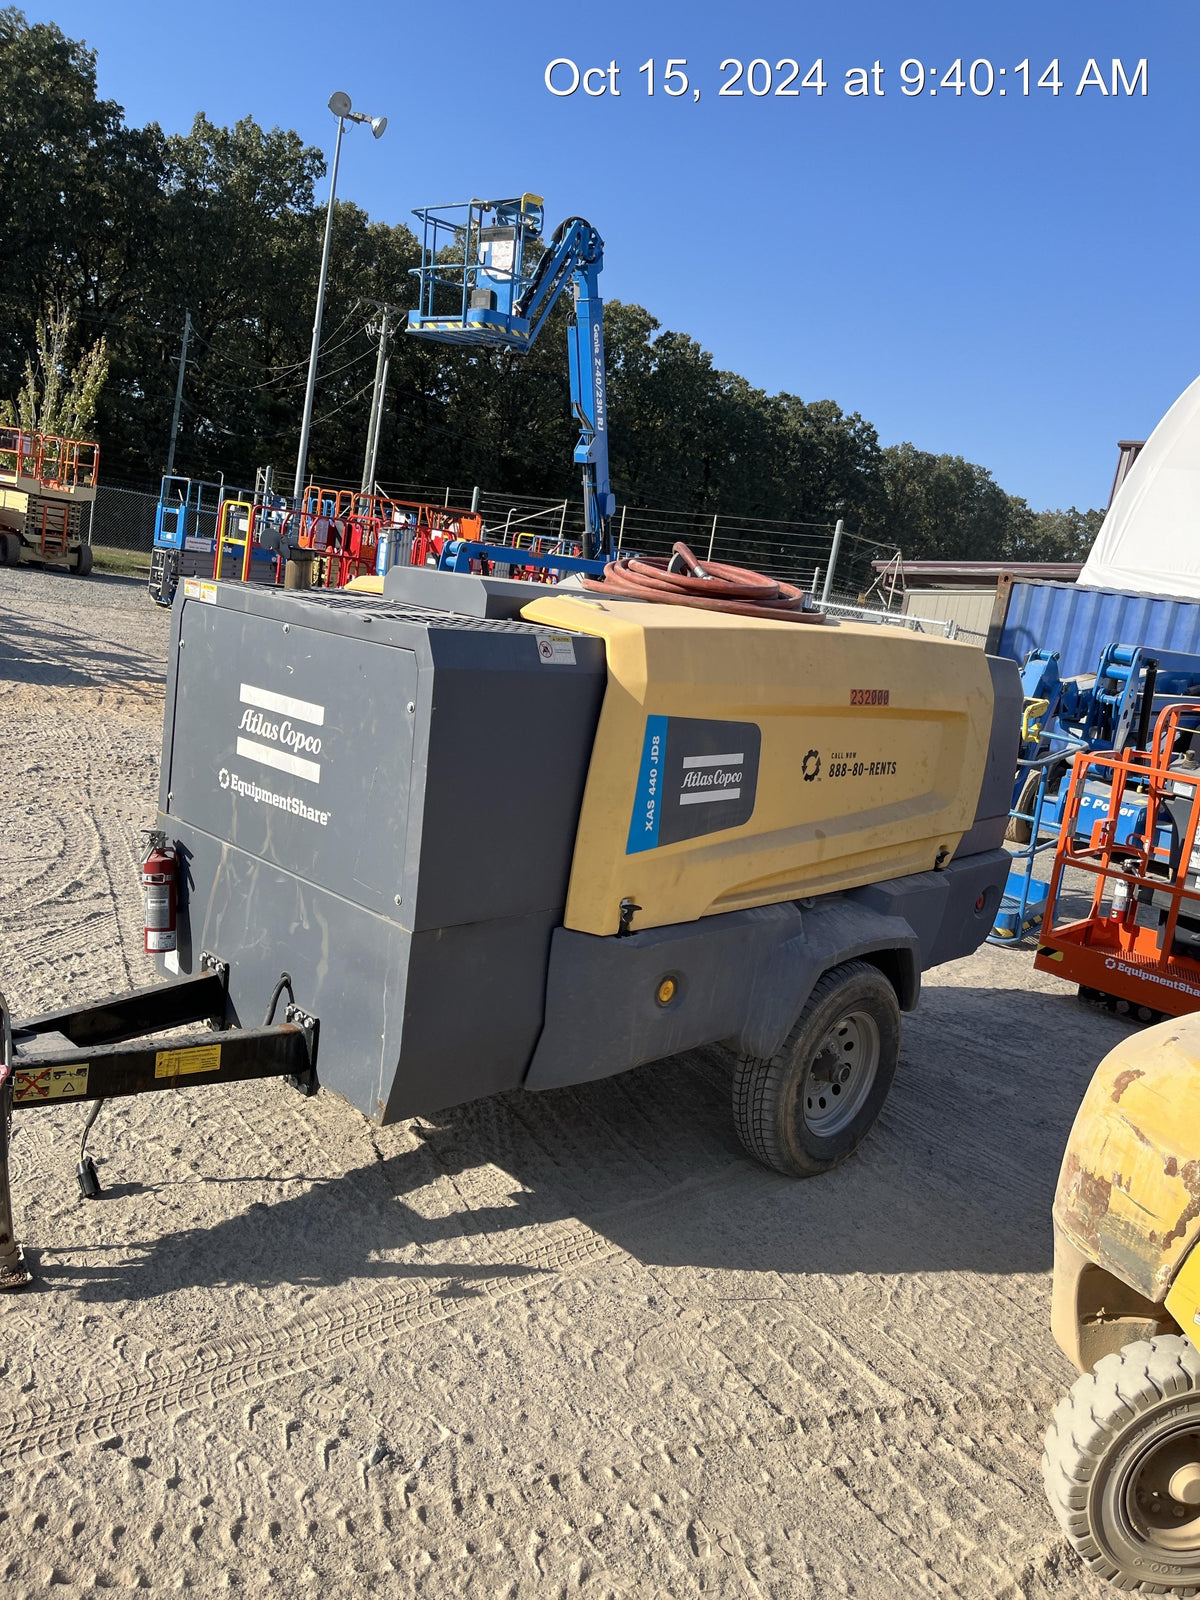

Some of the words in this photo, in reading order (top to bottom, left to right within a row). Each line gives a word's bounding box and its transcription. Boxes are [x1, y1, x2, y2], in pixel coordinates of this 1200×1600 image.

[594, 358, 604, 414] Z-40/23N
[597, 417, 604, 431] RJ
[850, 689, 889, 705] 232000
[238, 709, 279, 741] Atlas
[279, 721, 322, 755] Copco
[650, 735, 660, 765] JD8
[831, 752, 844, 760] CALL
[681, 771, 713, 789] Atlas
[713, 769, 743, 787] Copco
[829, 761, 897, 777] 888-80-RENTS
[648, 768, 658, 796] 440
[645, 799, 656, 831] XAS
[1092, 798, 1135, 818] Poer
